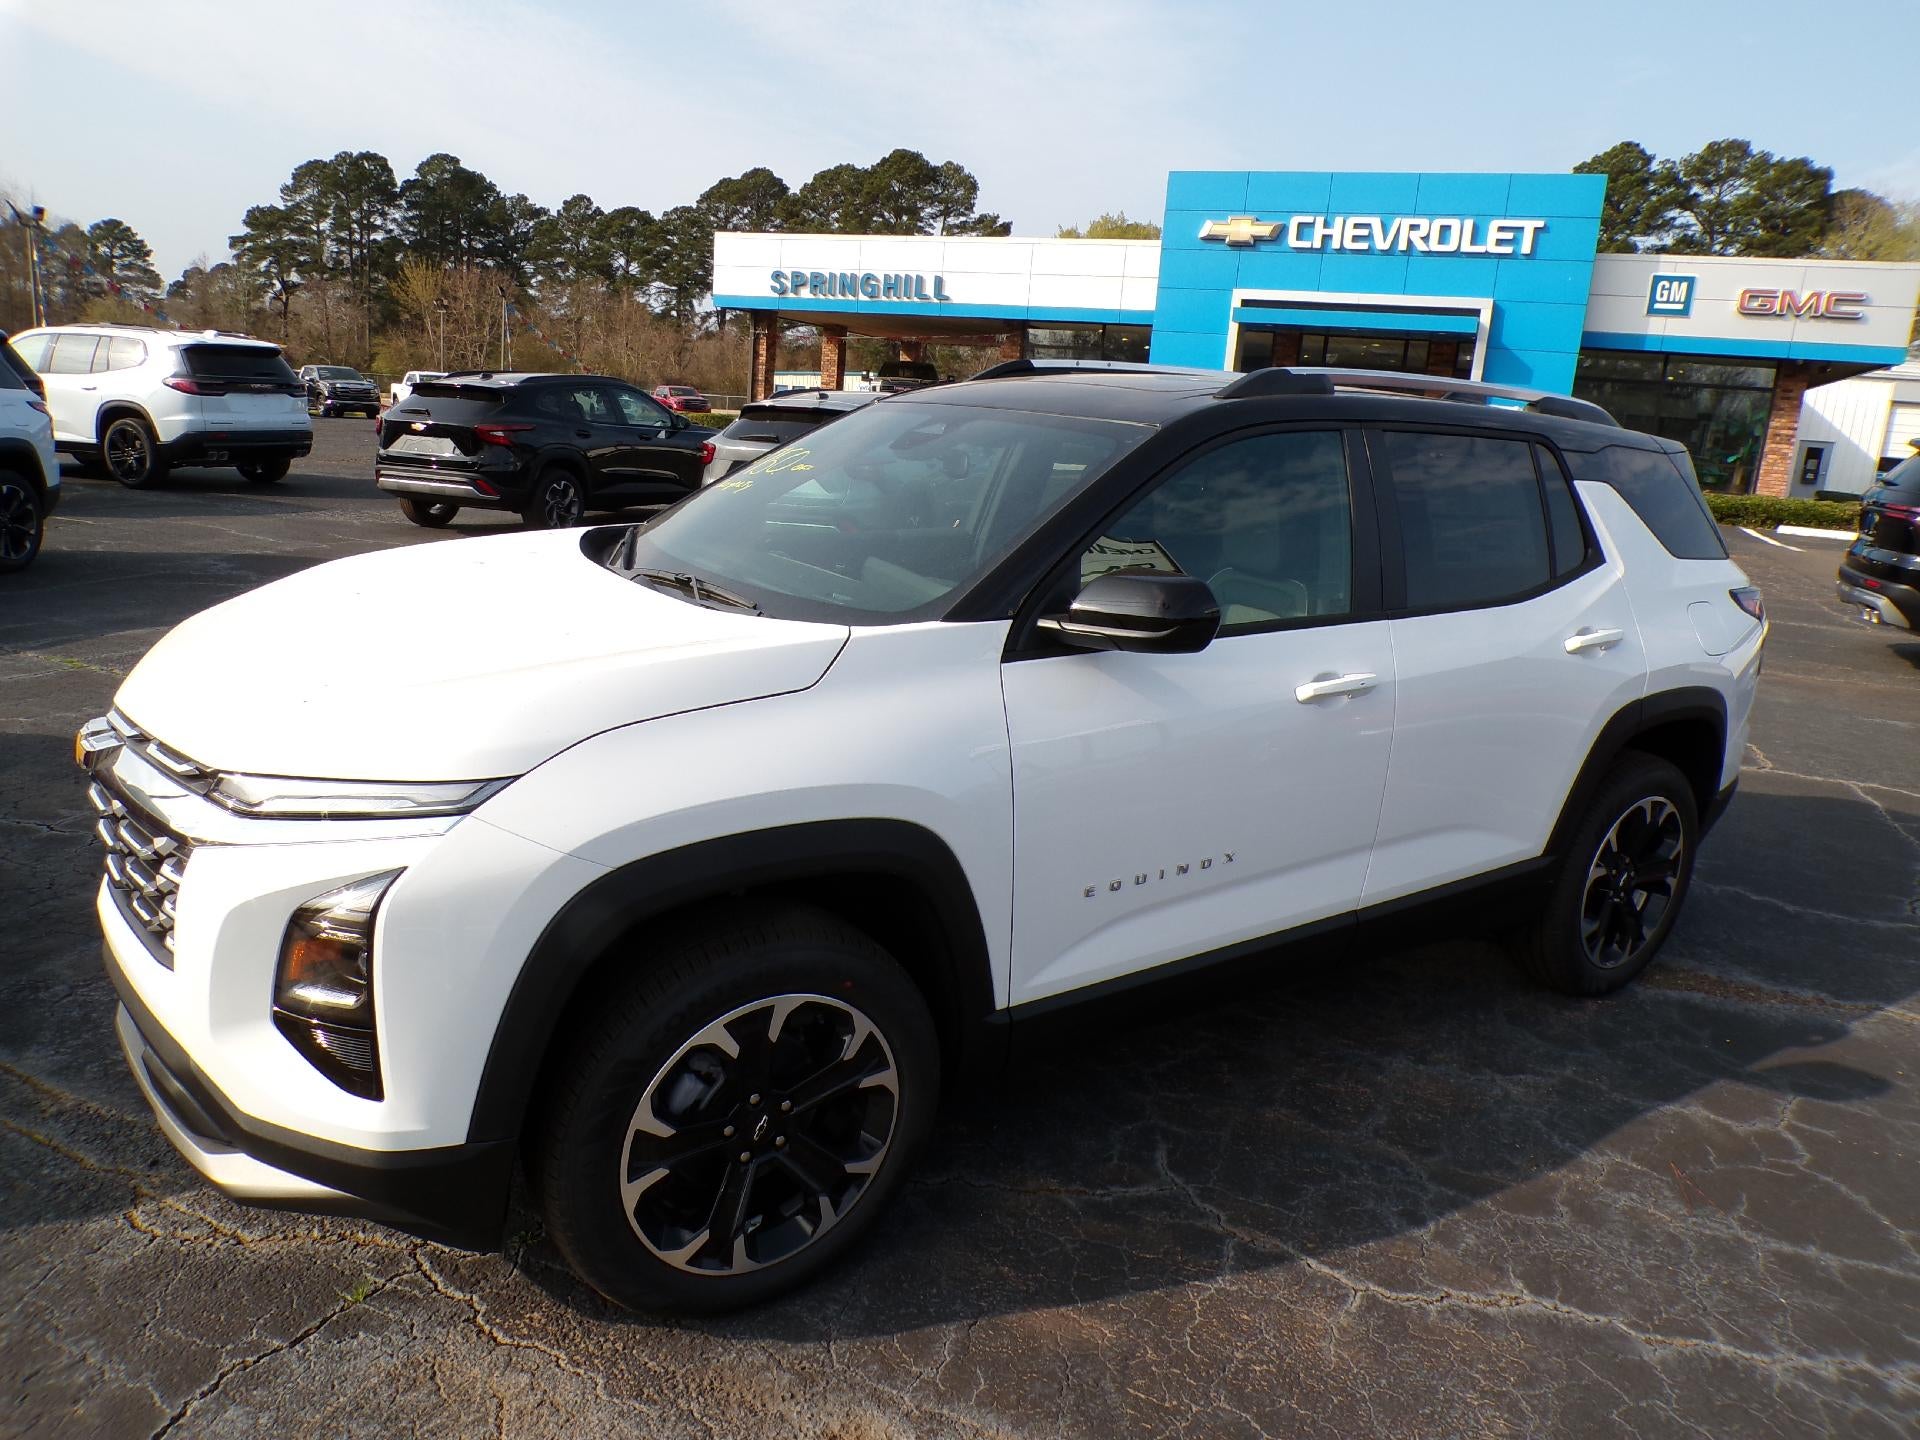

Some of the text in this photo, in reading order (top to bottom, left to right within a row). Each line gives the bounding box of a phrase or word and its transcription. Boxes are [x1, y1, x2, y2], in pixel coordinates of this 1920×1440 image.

[1287, 215, 1545, 255] CHEVROLET
[770, 270, 951, 301] SPRINGHILL
[1655, 280, 1688, 302] GM
[1737, 287, 1868, 320] GMC
[1084, 852, 1236, 898] EQUINOX
